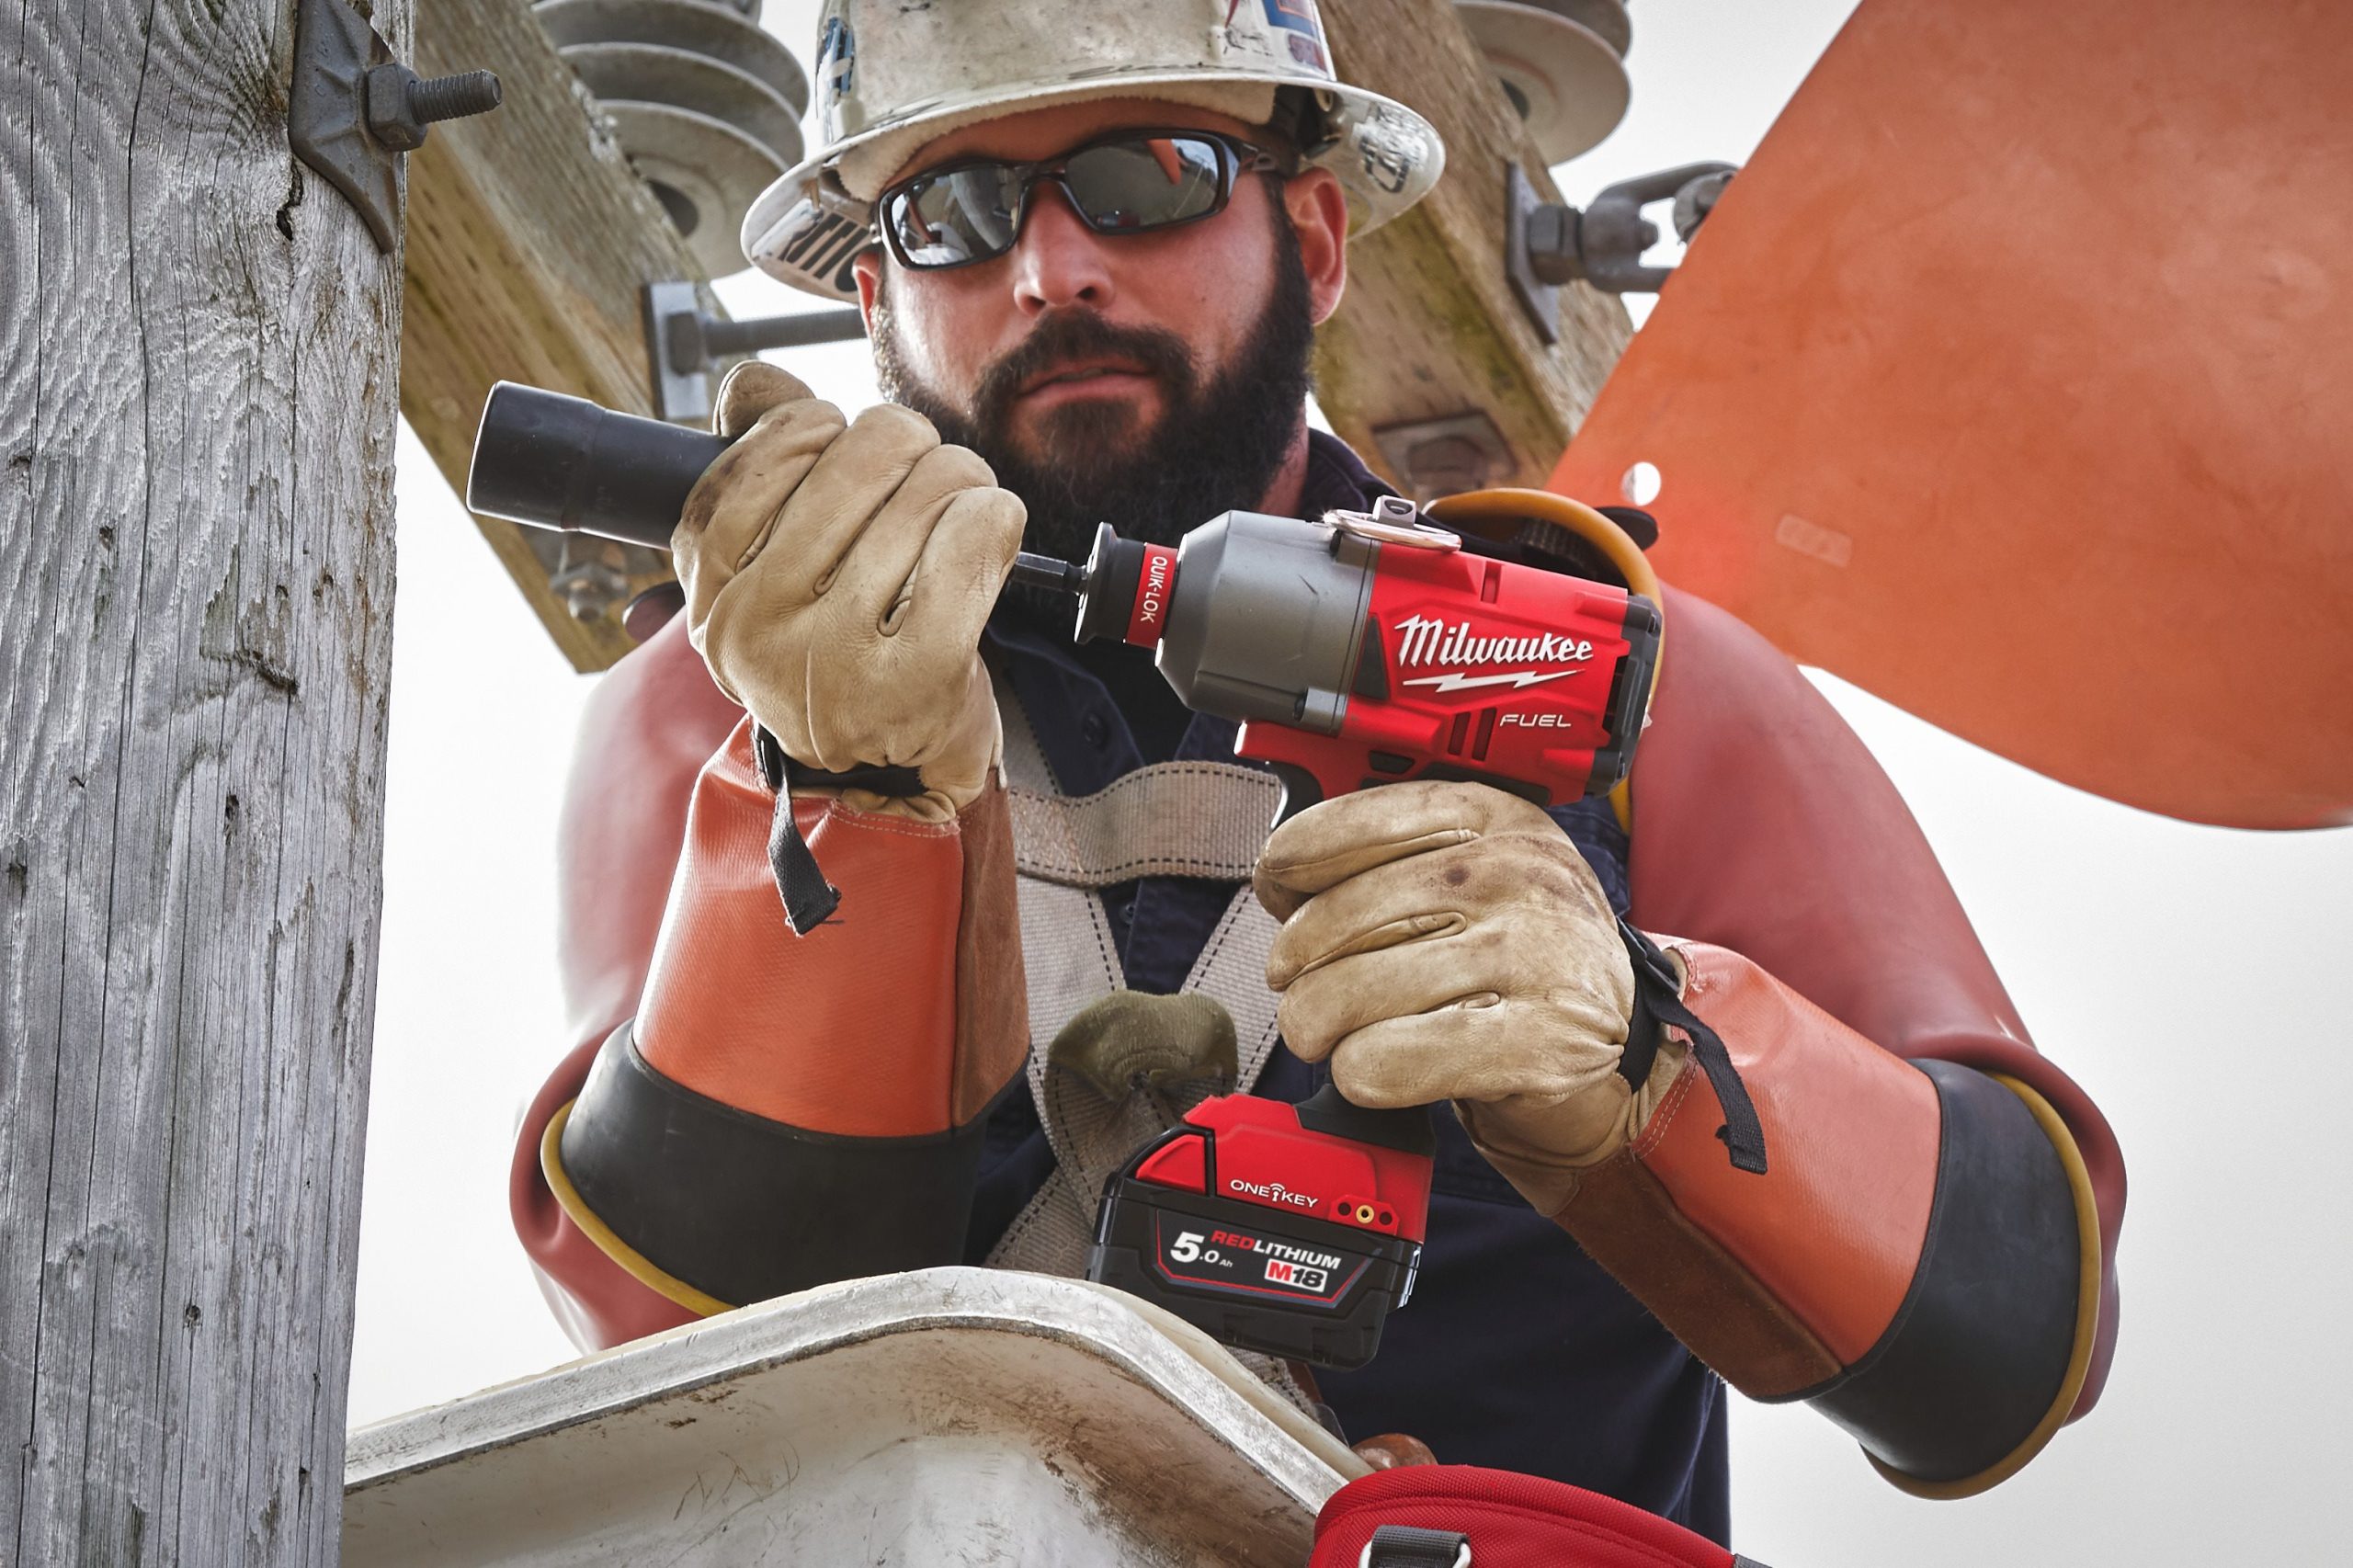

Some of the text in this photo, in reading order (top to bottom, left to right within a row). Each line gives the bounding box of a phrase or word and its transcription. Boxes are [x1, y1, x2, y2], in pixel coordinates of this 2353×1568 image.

[1140, 556, 1168, 623] QUIK-LOK
[1394, 613, 1594, 667] Milwaukee
[1500, 714, 1572, 727] FUEL
[1170, 1231, 1233, 1268] 5.0 Ah
[1211, 1230, 1341, 1269] REDLITHIUM
[1267, 1261, 1324, 1289] M18
